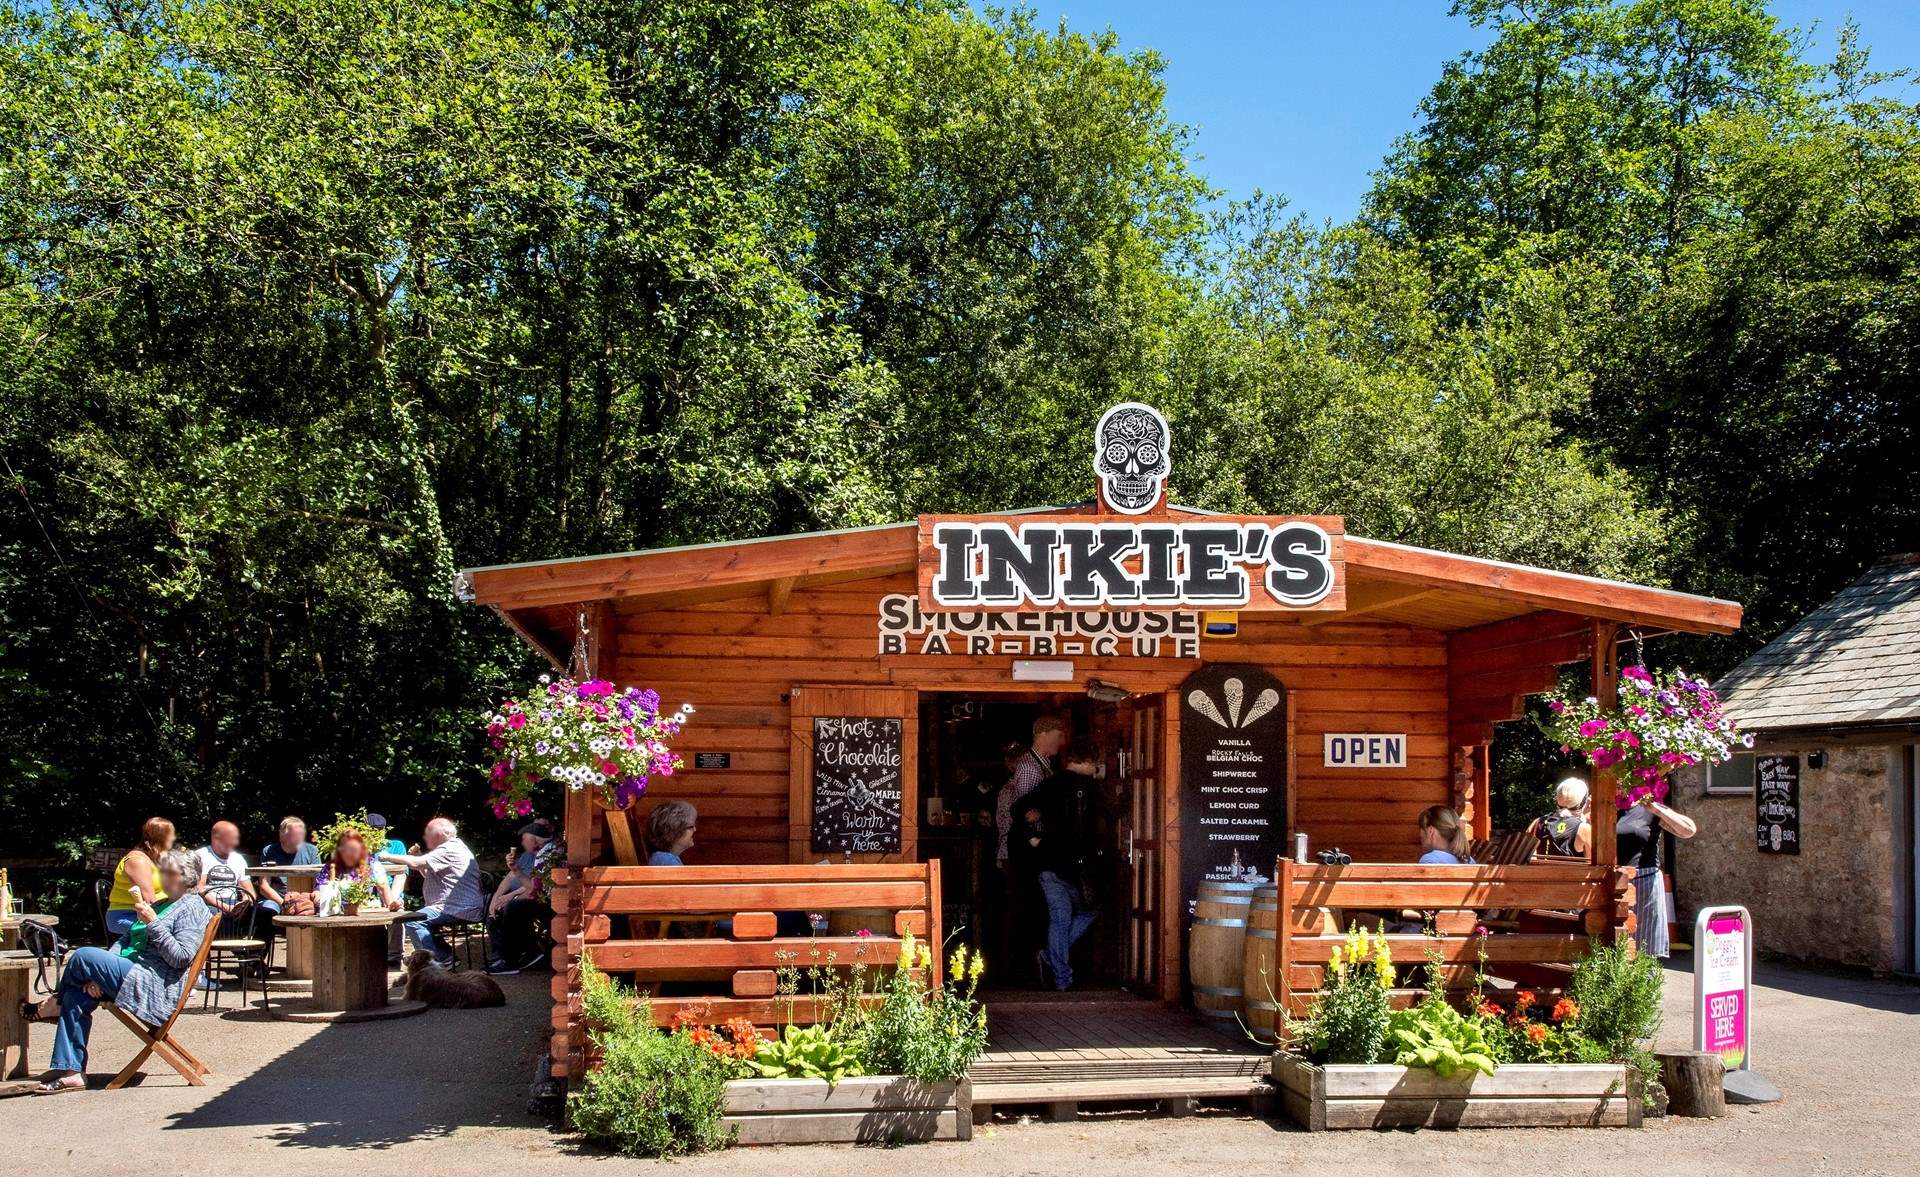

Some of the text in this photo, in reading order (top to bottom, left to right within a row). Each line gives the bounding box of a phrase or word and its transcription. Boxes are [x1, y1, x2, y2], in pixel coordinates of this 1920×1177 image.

[936, 526, 1330, 602] INKIE'S
[882, 598, 1197, 634] SMOKEHOUSE
[834, 717, 873, 738] hot
[819, 741, 901, 767] Chocolate
[1331, 737, 1400, 764] OPEN
[875, 789, 901, 799] MAPLE
[1710, 995, 1739, 1018] SERVED
[1714, 1017, 1735, 1039] HERE
